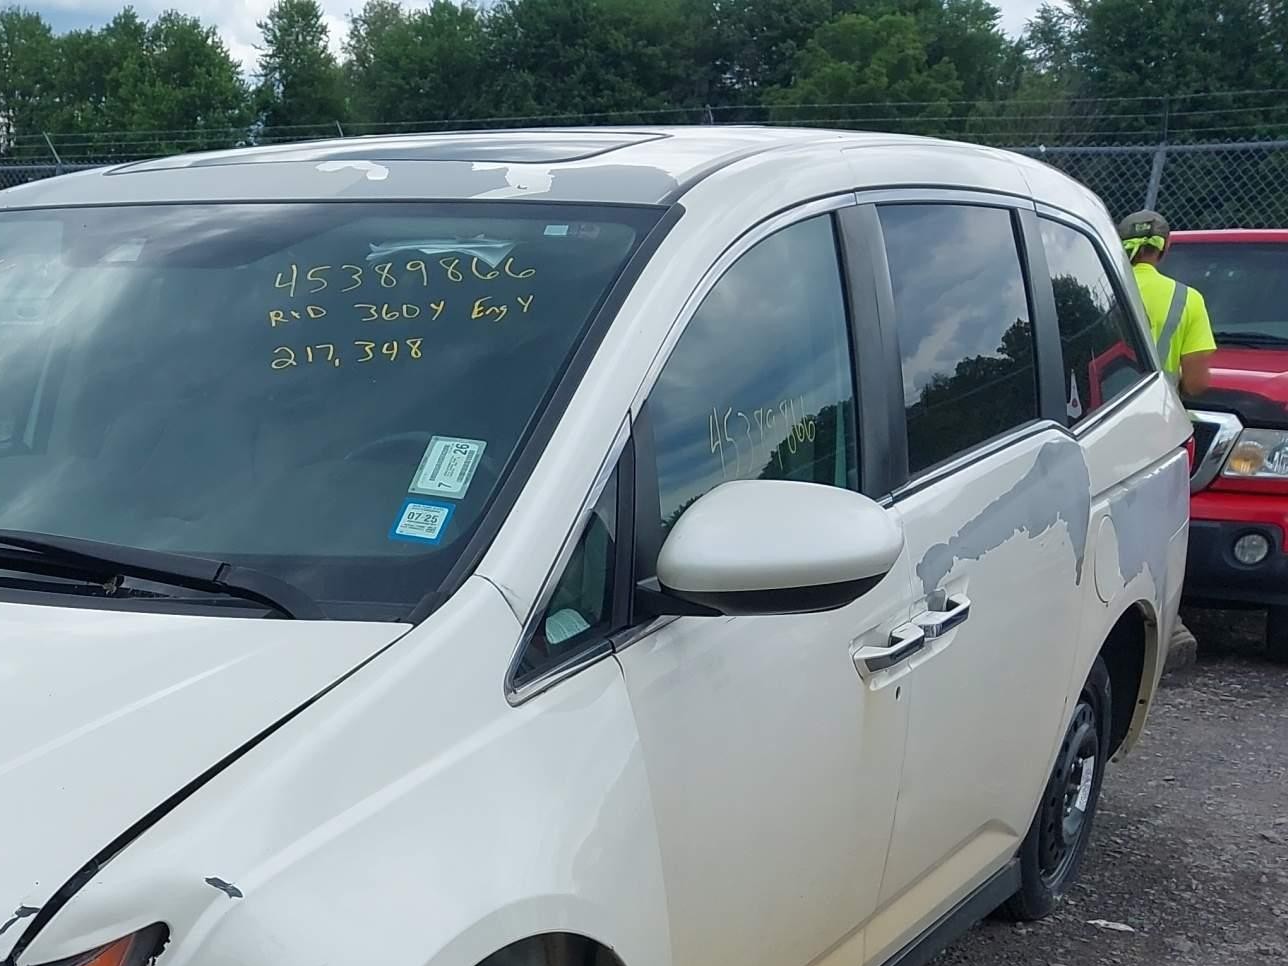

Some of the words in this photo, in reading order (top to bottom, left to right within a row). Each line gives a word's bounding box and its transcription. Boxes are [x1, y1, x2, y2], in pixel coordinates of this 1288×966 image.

[274, 257, 536, 298] 45389866
[471, 295, 508, 323] Eng
[516, 295, 534, 313] Y
[453, 443, 470, 456] 26
